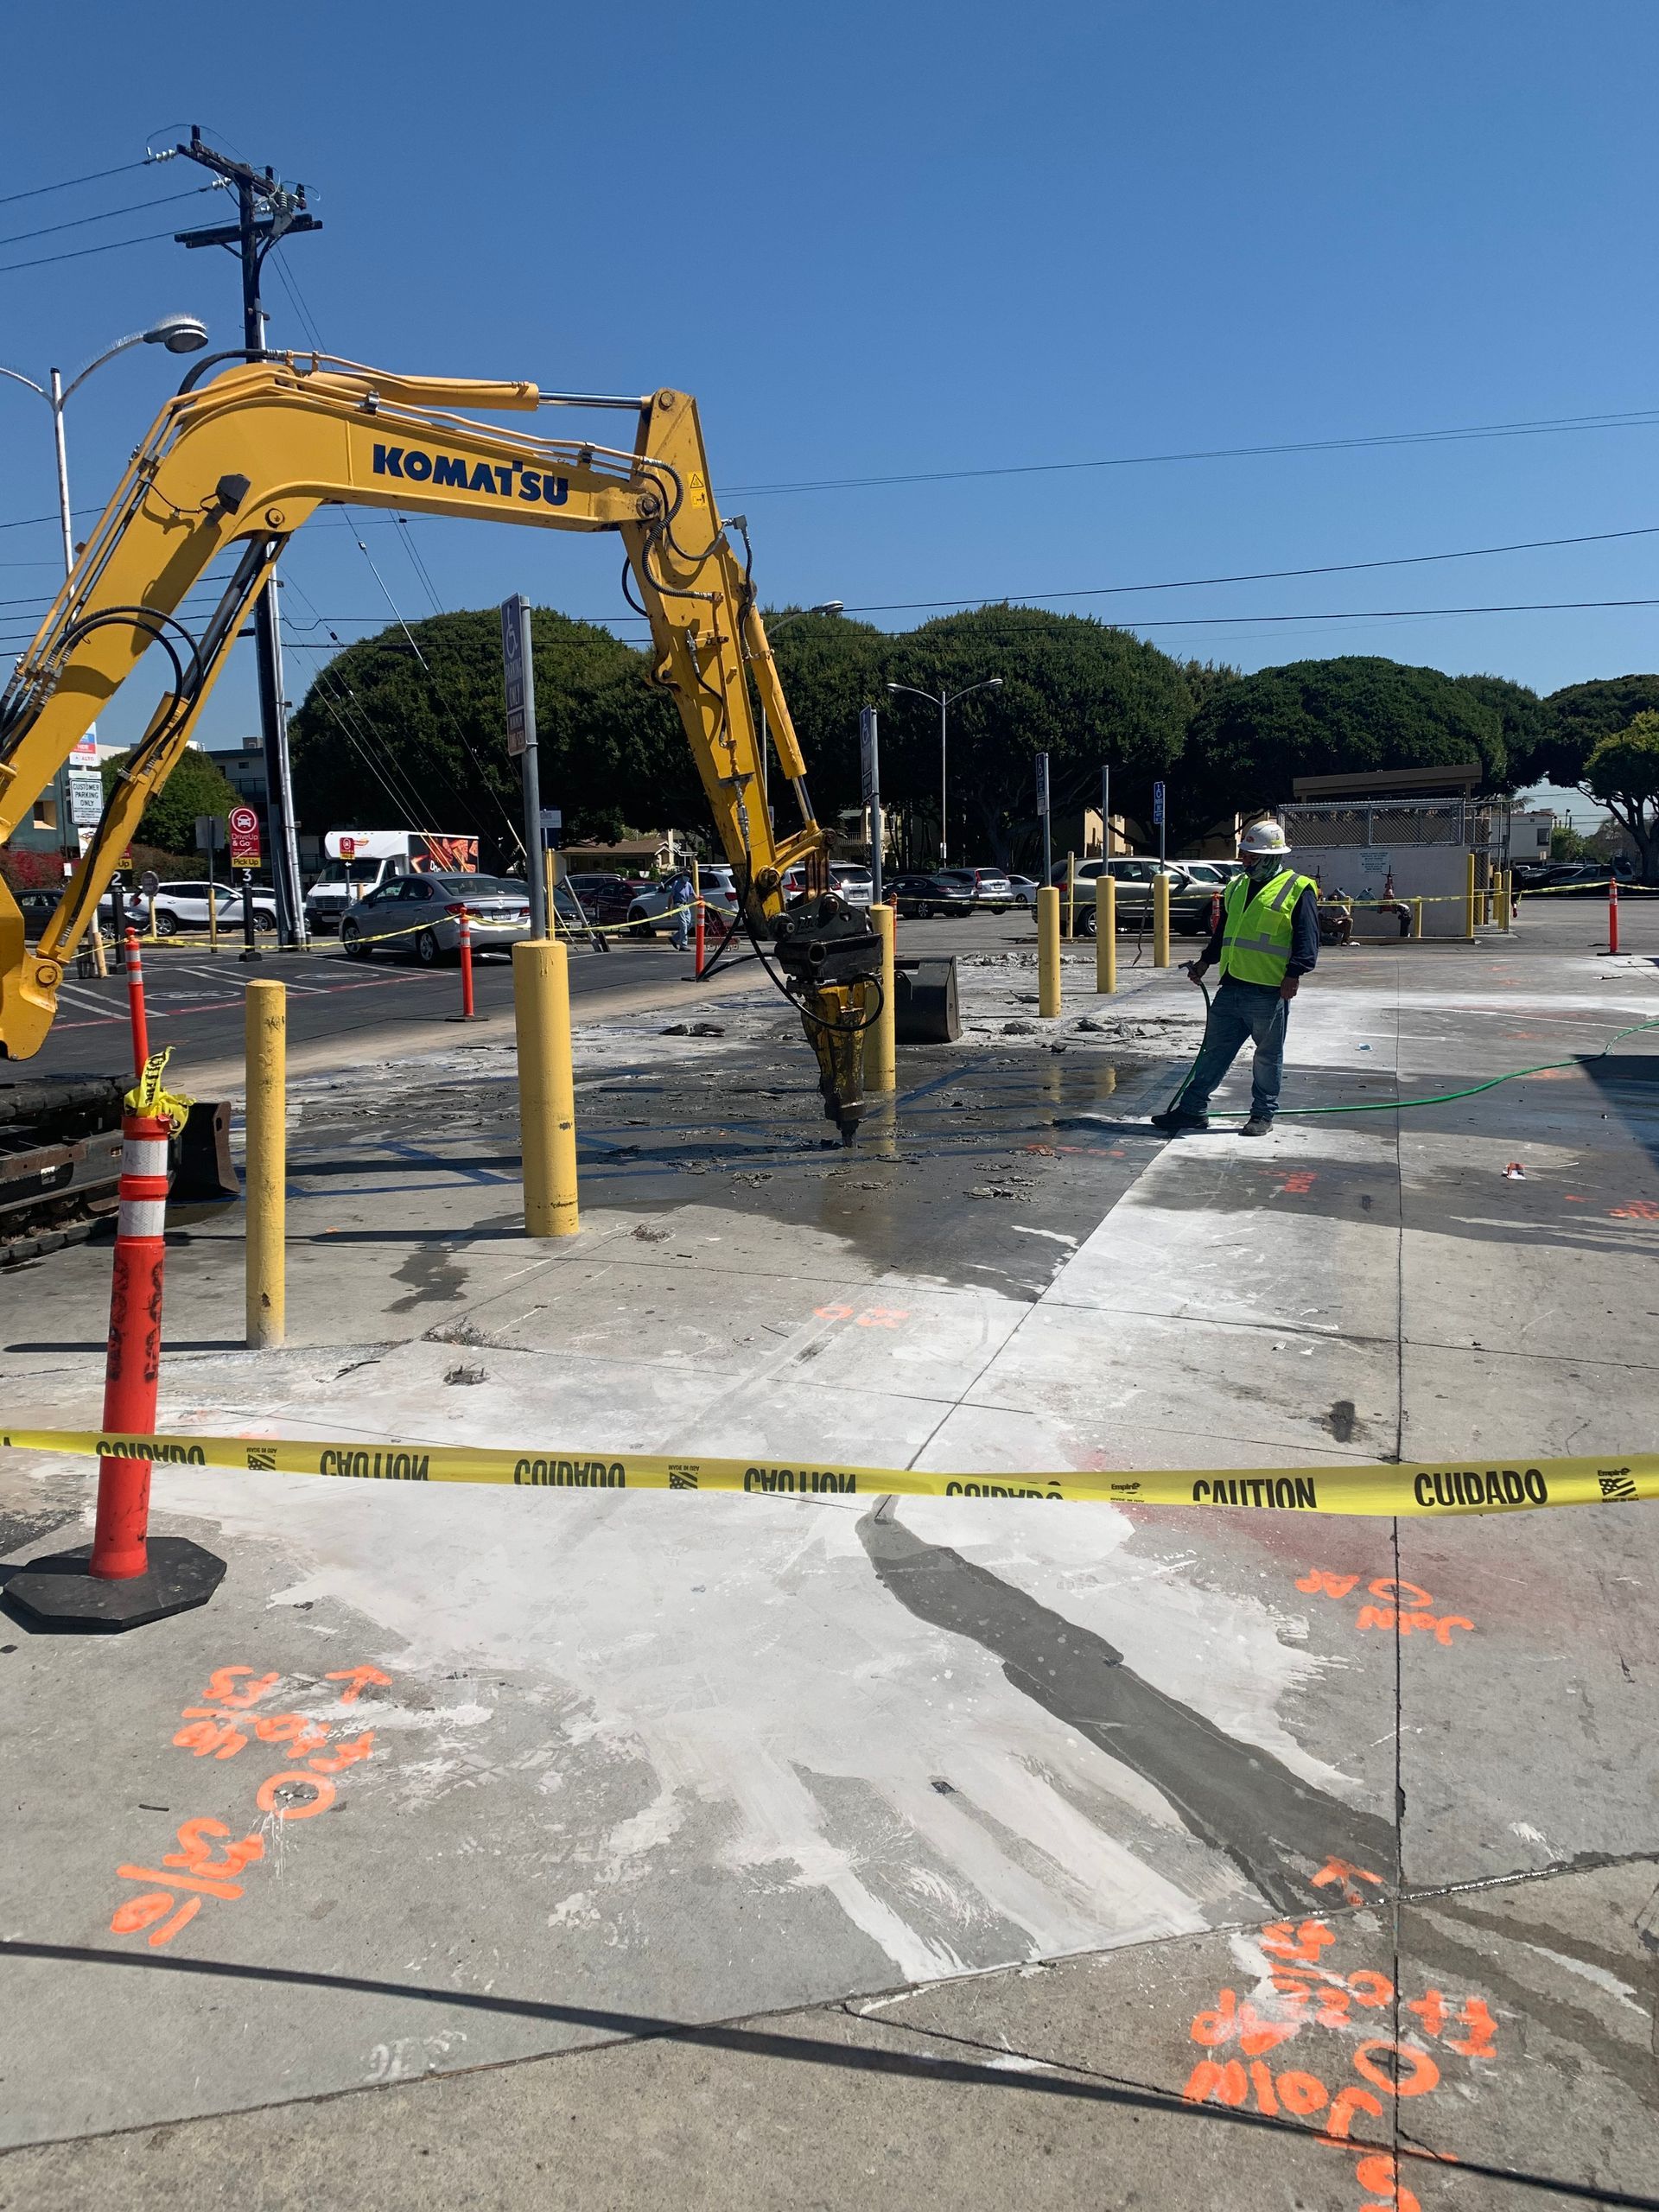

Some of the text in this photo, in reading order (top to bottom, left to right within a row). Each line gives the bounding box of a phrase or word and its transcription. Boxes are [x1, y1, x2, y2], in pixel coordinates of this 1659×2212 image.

[373, 444, 569, 505] KOMATSU
[111, 871, 122, 885] 2
[242, 868, 251, 881] 3
[1193, 1478, 1318, 1509] CAUTION
[1414, 1469, 1548, 1508] CUIDADO
